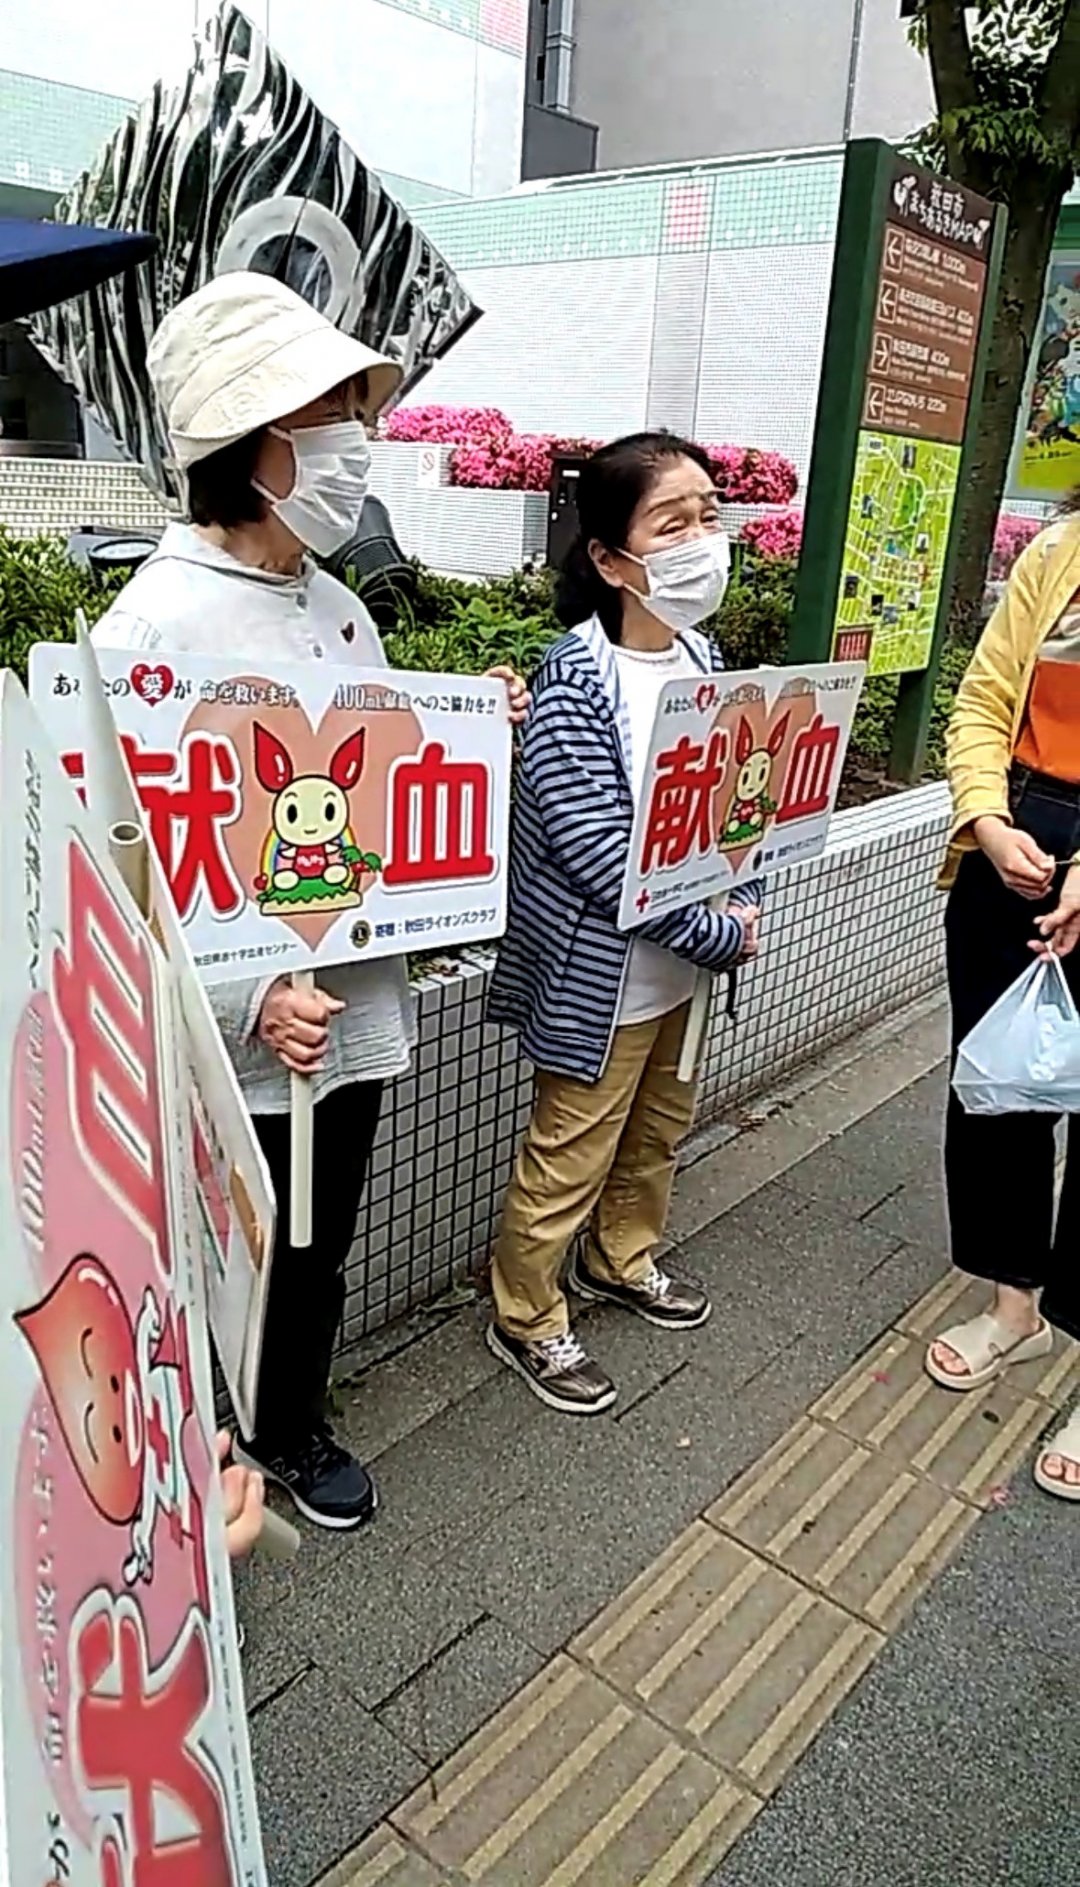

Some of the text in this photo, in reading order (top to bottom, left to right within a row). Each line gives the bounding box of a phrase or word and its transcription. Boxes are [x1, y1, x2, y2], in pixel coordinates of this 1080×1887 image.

[385, 742, 493, 885] 血
[640, 714, 840, 874] 献 血
